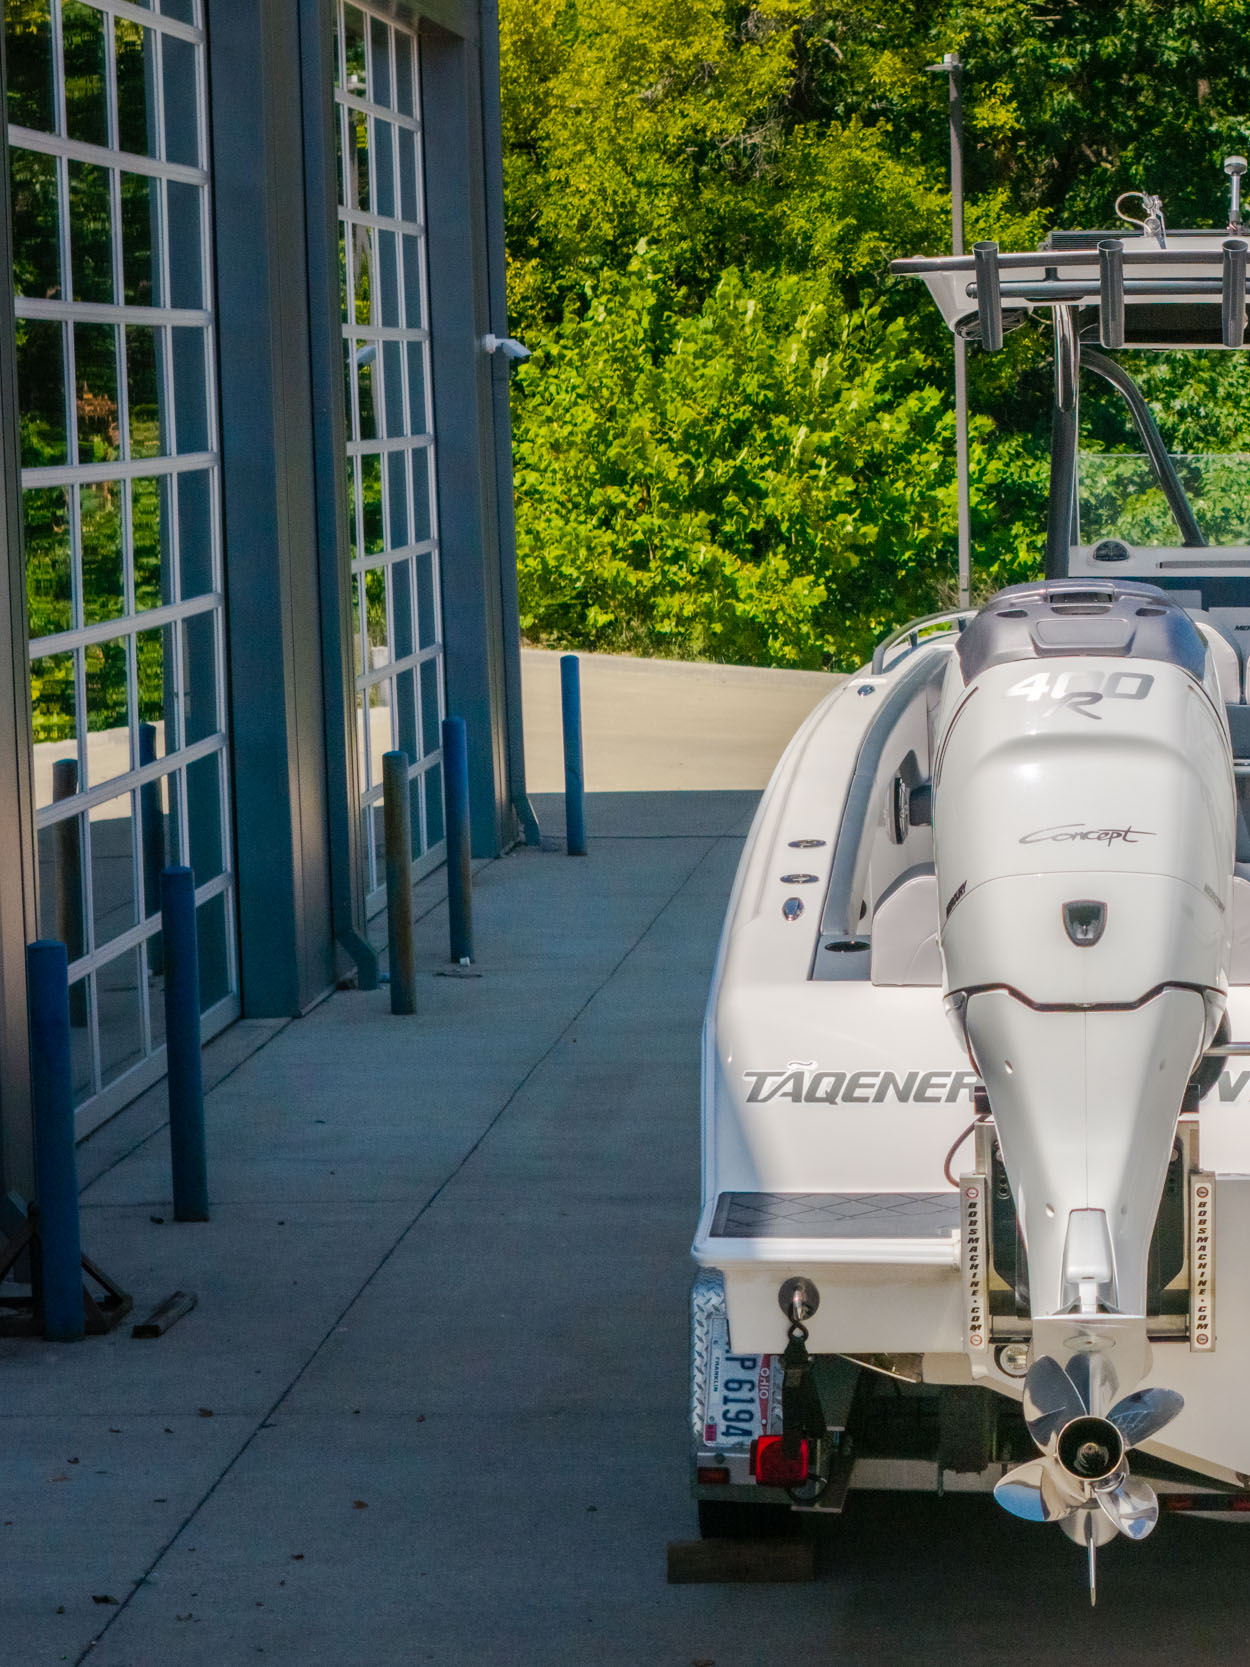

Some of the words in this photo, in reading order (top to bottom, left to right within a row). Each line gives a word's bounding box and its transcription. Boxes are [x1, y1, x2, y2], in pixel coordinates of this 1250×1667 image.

[1006, 672, 1155, 701] 400
[1042, 692, 1103, 720] R
[1019, 823, 1157, 847] Concept
[759, 1367, 770, 1399] OHIO
[721, 1378, 755, 1438] 6194
